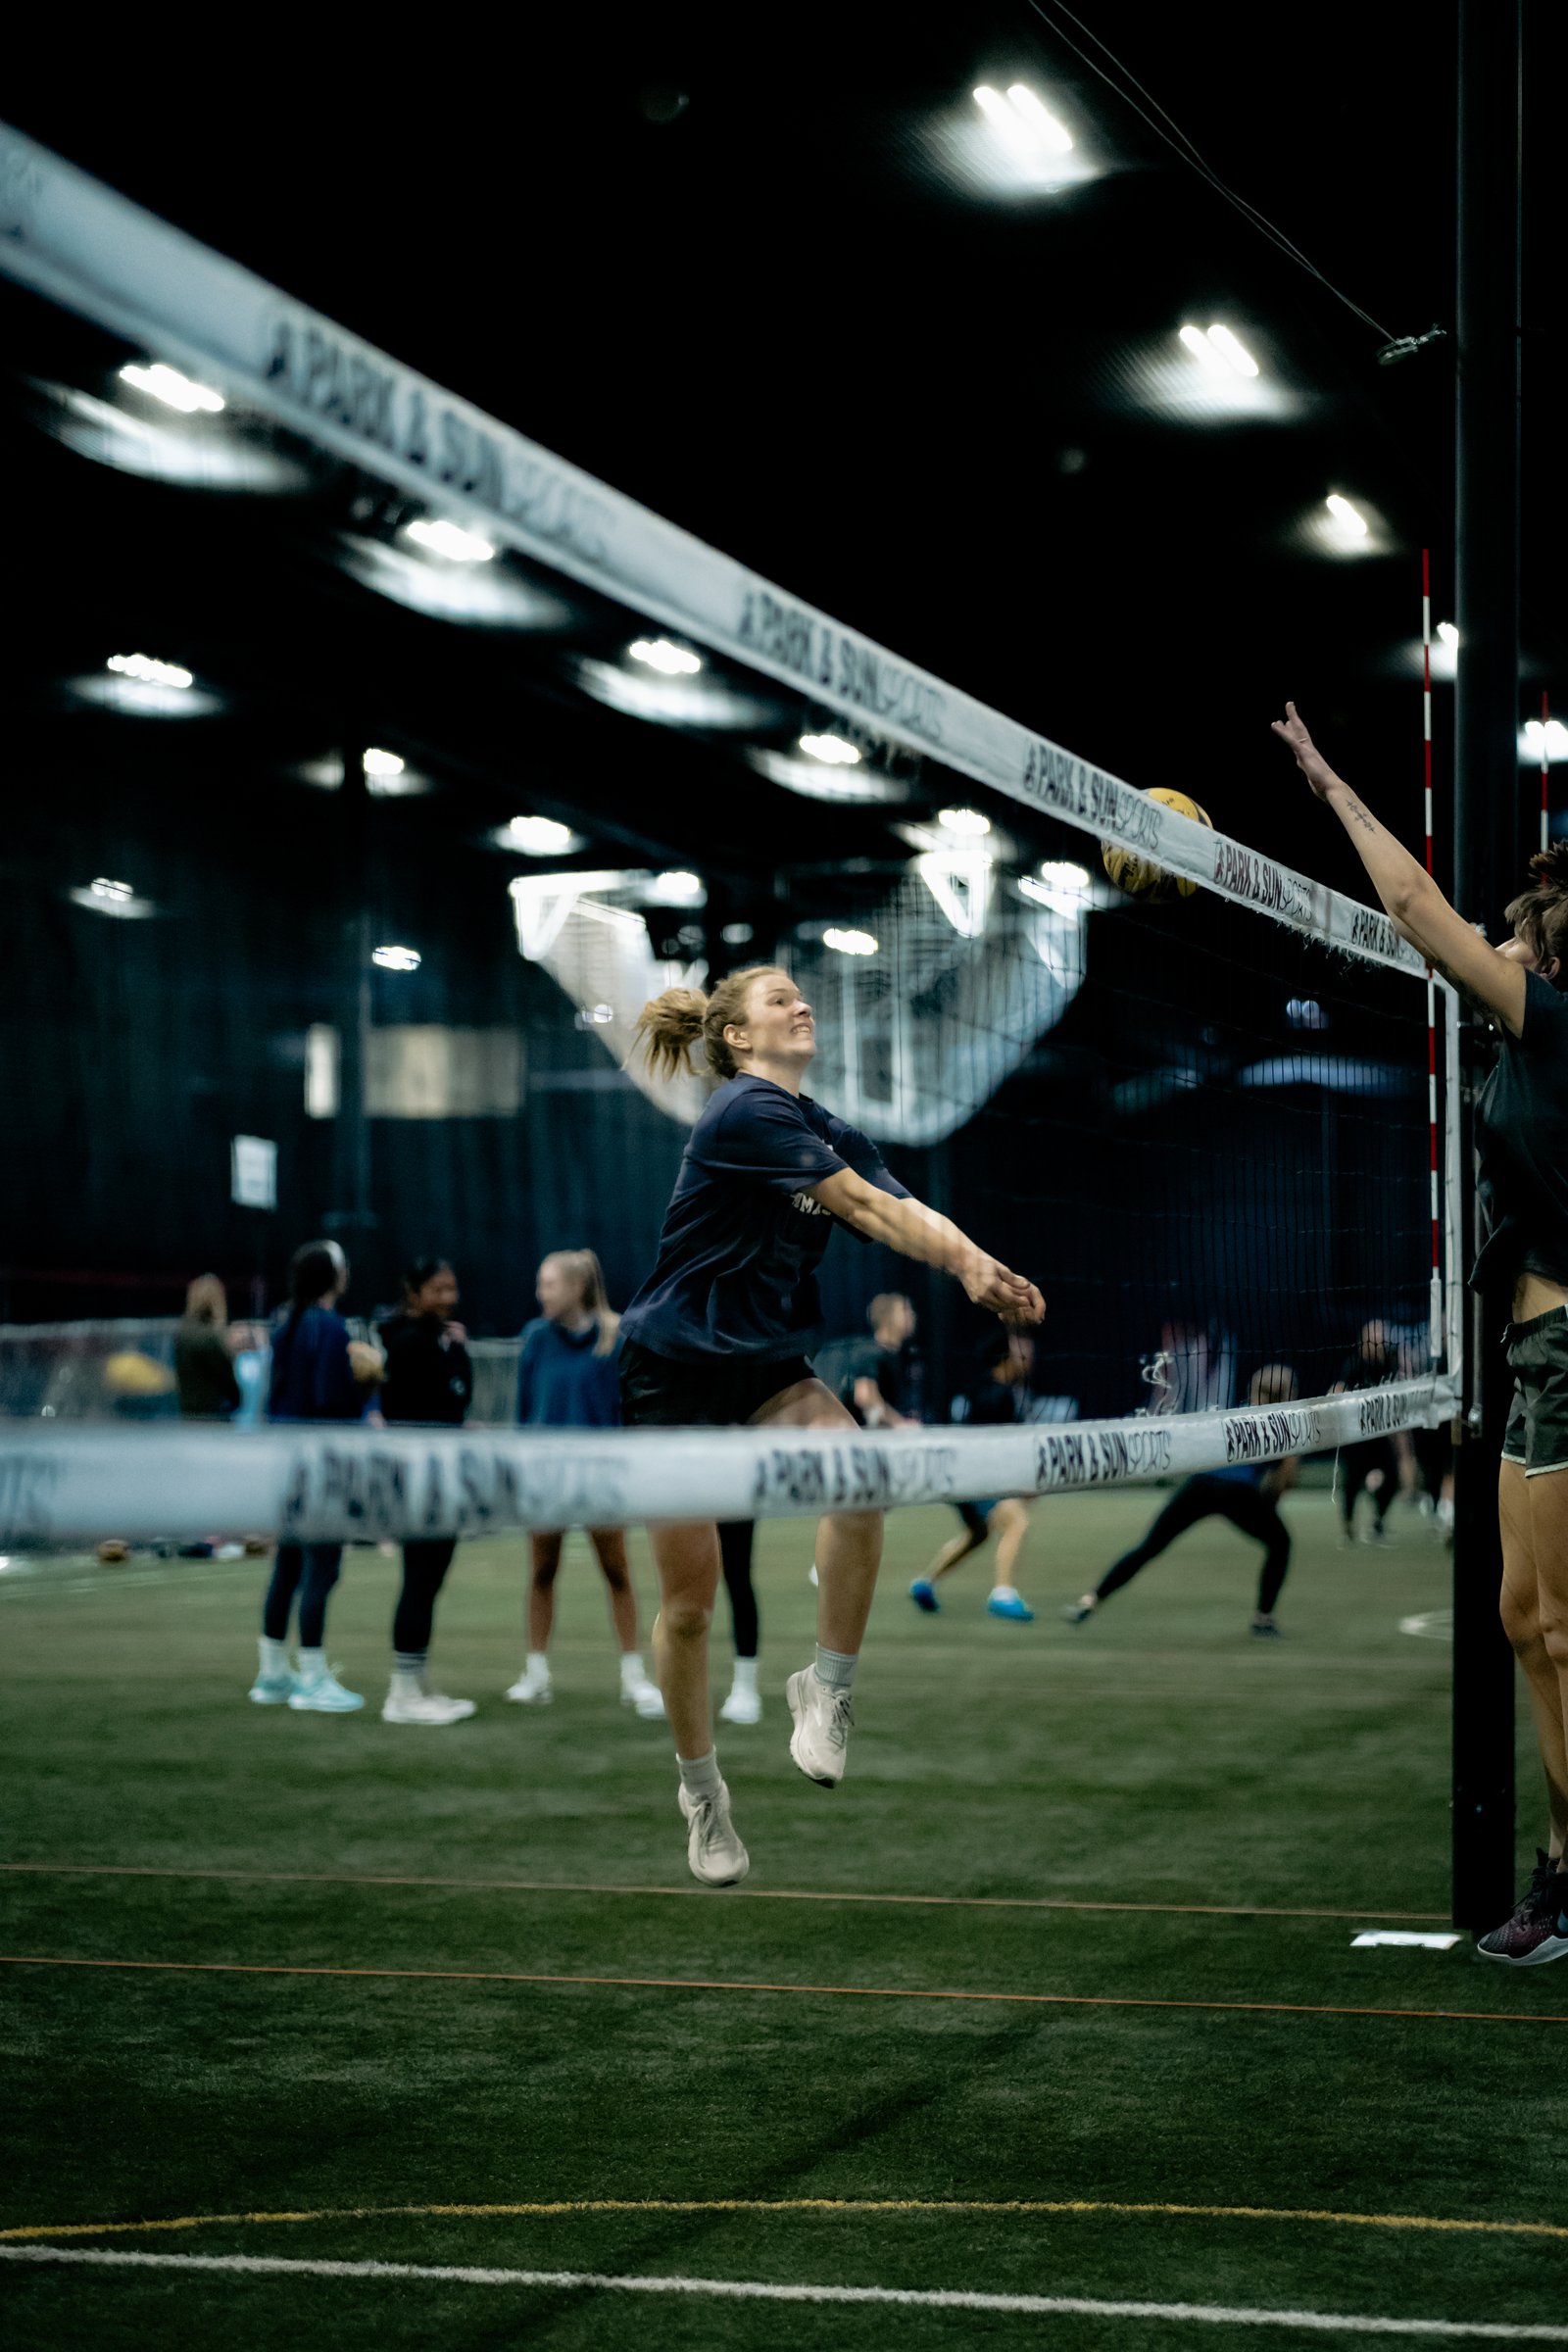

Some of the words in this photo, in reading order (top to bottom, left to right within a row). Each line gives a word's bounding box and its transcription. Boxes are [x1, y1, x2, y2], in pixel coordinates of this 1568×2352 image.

[1038, 744, 1074, 811] PARK
[1079, 763, 1087, 814] &
[1091, 771, 1118, 832] SUN
[1115, 791, 1162, 851] SPORTS
[1223, 844, 1250, 897] PARK
[1252, 858, 1260, 900] &
[1261, 862, 1282, 910] SUN
[1358, 908, 1380, 953] PARK
[1230, 1416, 1261, 1459] PARK
[1260, 1415, 1270, 1456] &
[1268, 1411, 1291, 1453] SUN
[1364, 1396, 1385, 1434] PARK
[1048, 1434, 1085, 1488] PARK
[1088, 1432, 1099, 1482] &
[1099, 1431, 1128, 1481] SUN
[1127, 1430, 1172, 1476] SPORTS
